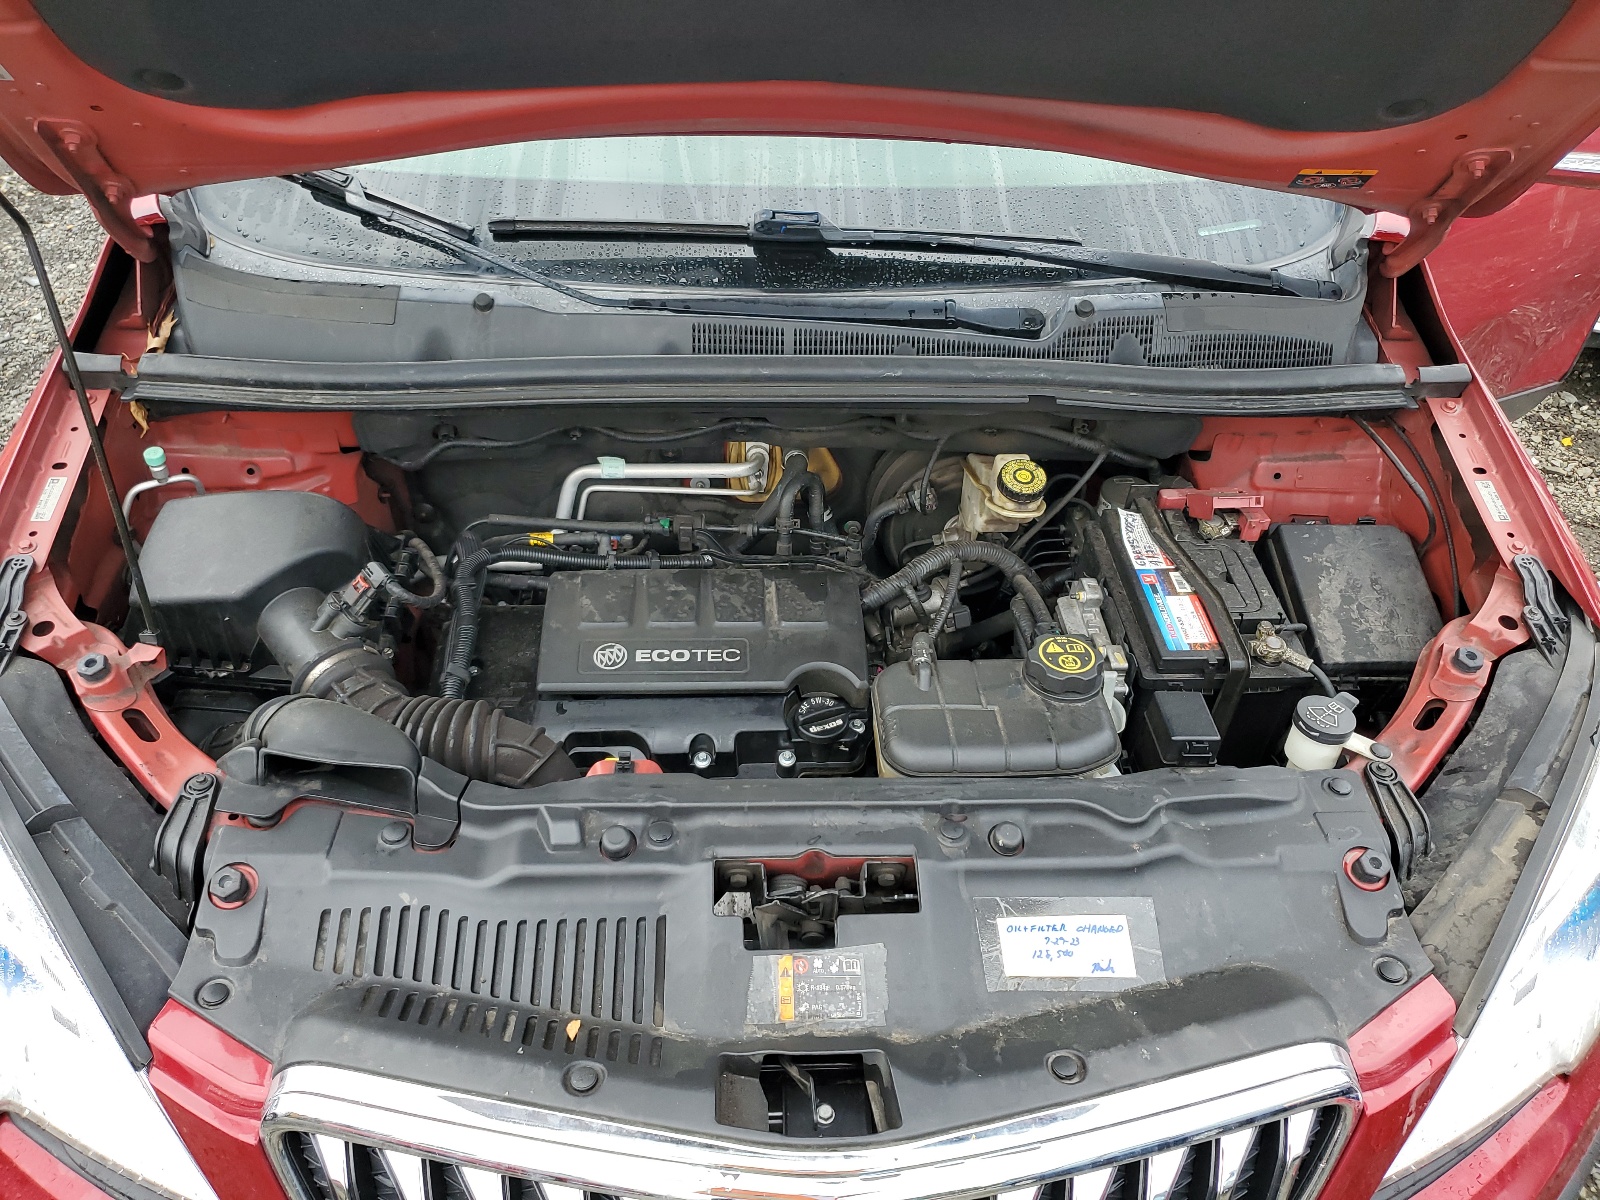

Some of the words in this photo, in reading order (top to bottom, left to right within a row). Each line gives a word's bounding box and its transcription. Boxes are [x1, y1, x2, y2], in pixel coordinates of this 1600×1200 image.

[635, 649, 741, 662] ECOTEC
[798, 701, 811, 714] SAE
[810, 697, 835, 707] 5W-30
[809, 718, 843, 733] dexos
[1076, 923, 1124, 934] CHANGED
